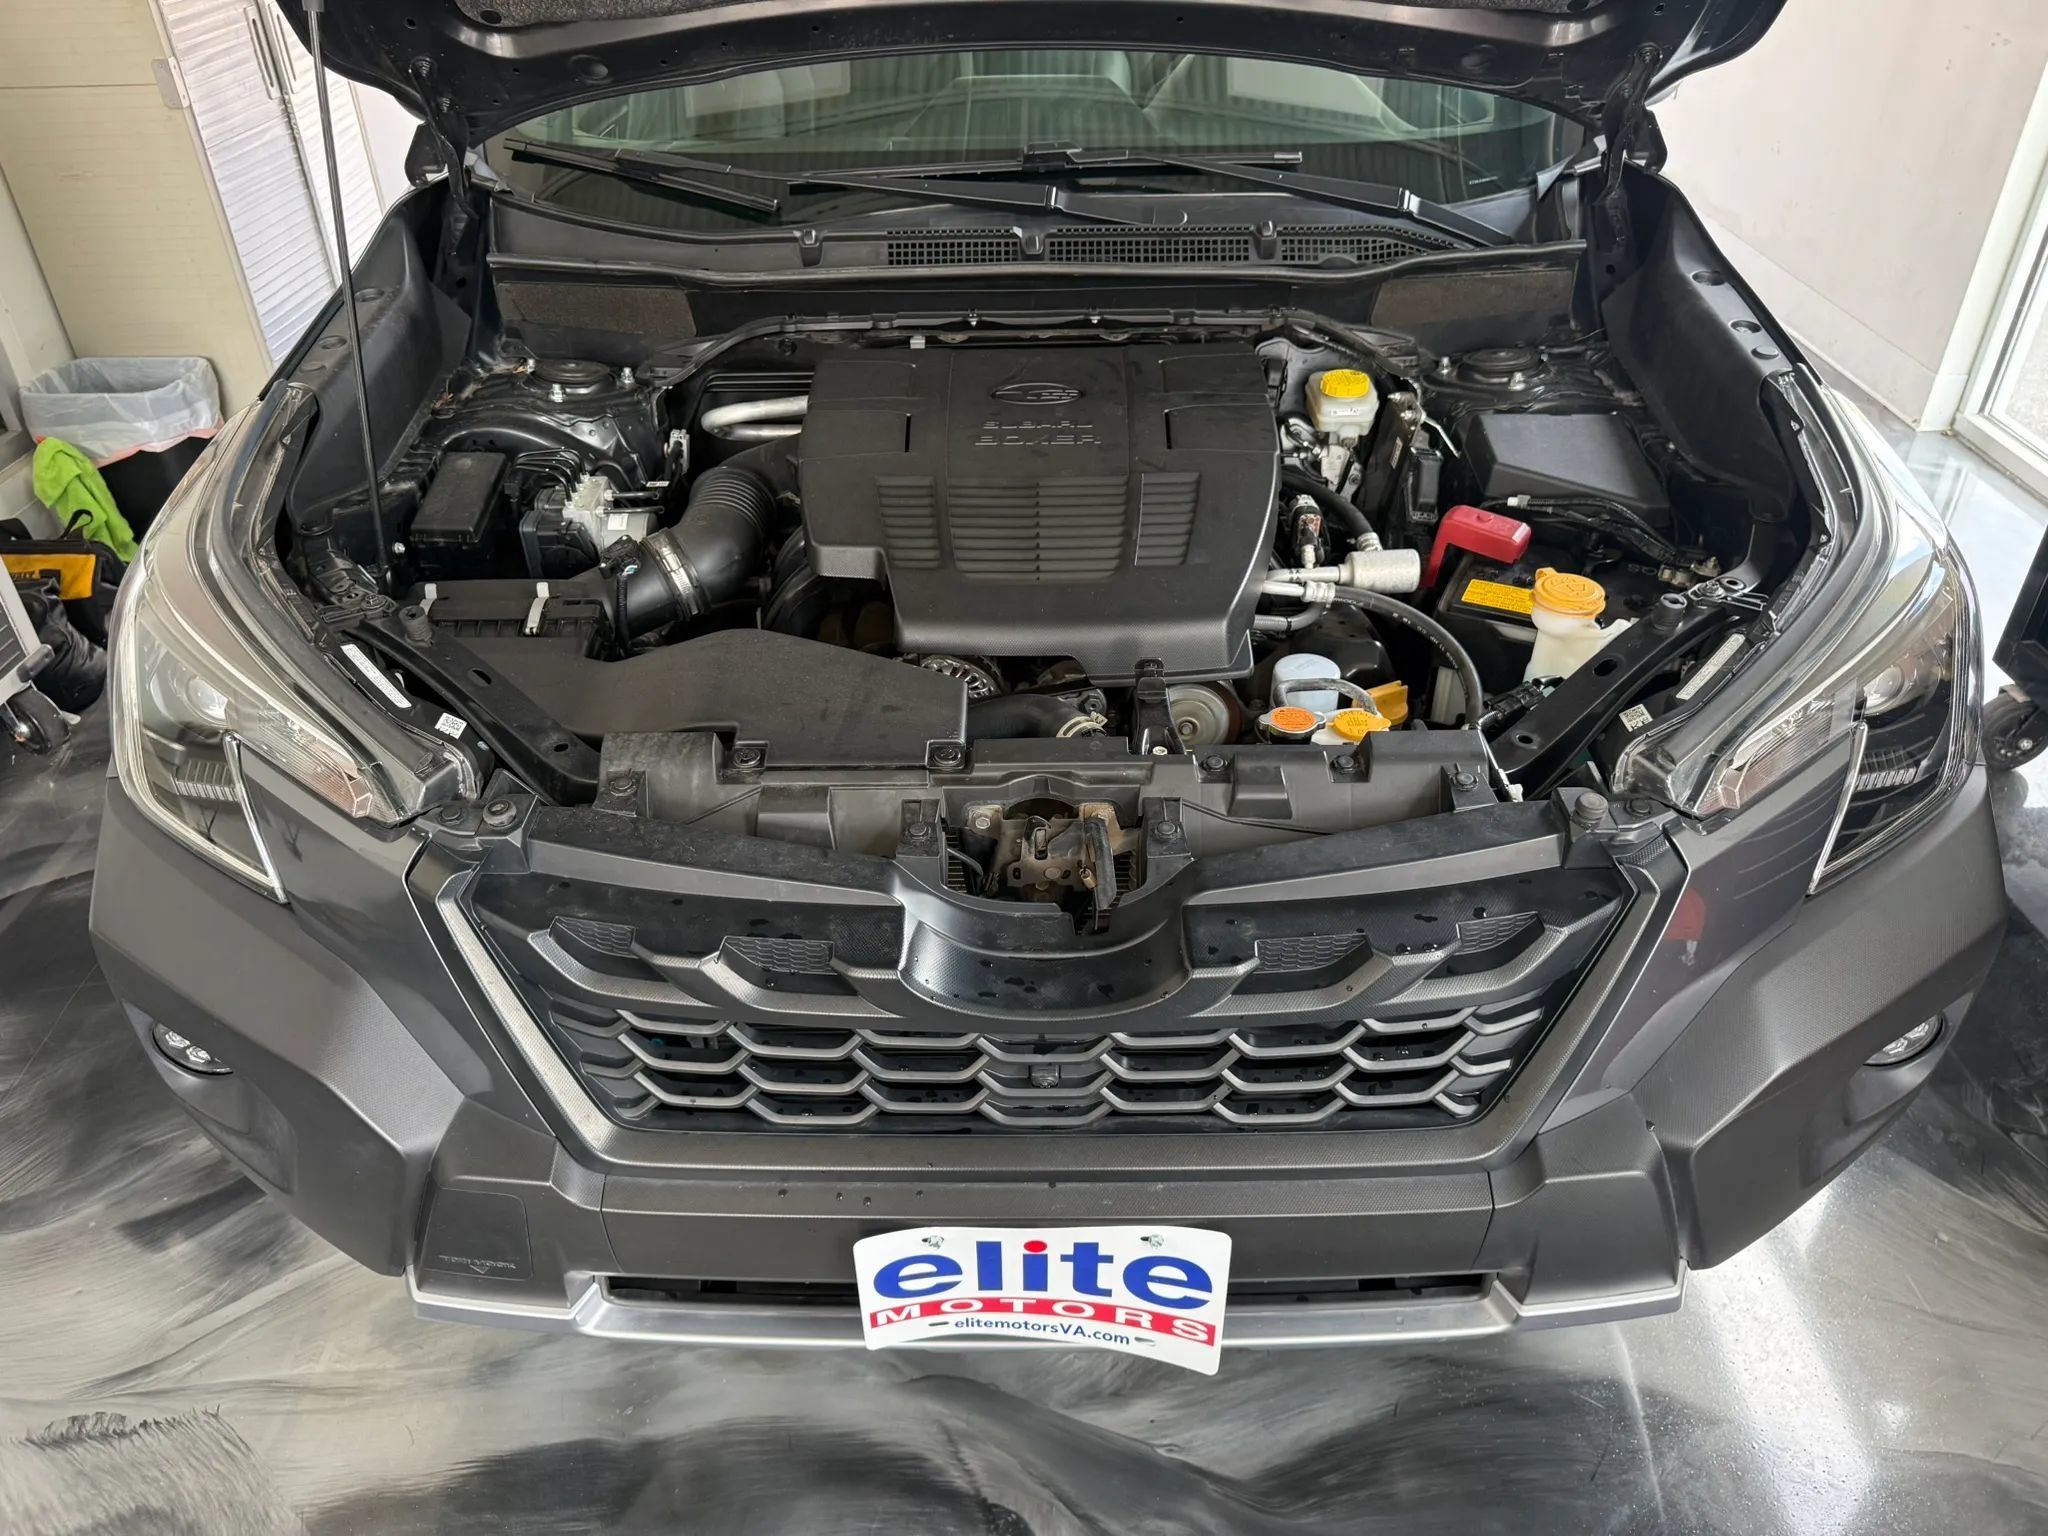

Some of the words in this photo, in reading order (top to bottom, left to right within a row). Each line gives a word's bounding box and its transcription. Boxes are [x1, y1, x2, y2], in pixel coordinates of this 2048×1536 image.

[873, 1240, 1213, 1310] elite
[876, 1298, 1209, 1342] MOTORS
[954, 1317, 1130, 1345] elitemotorsVA.com
